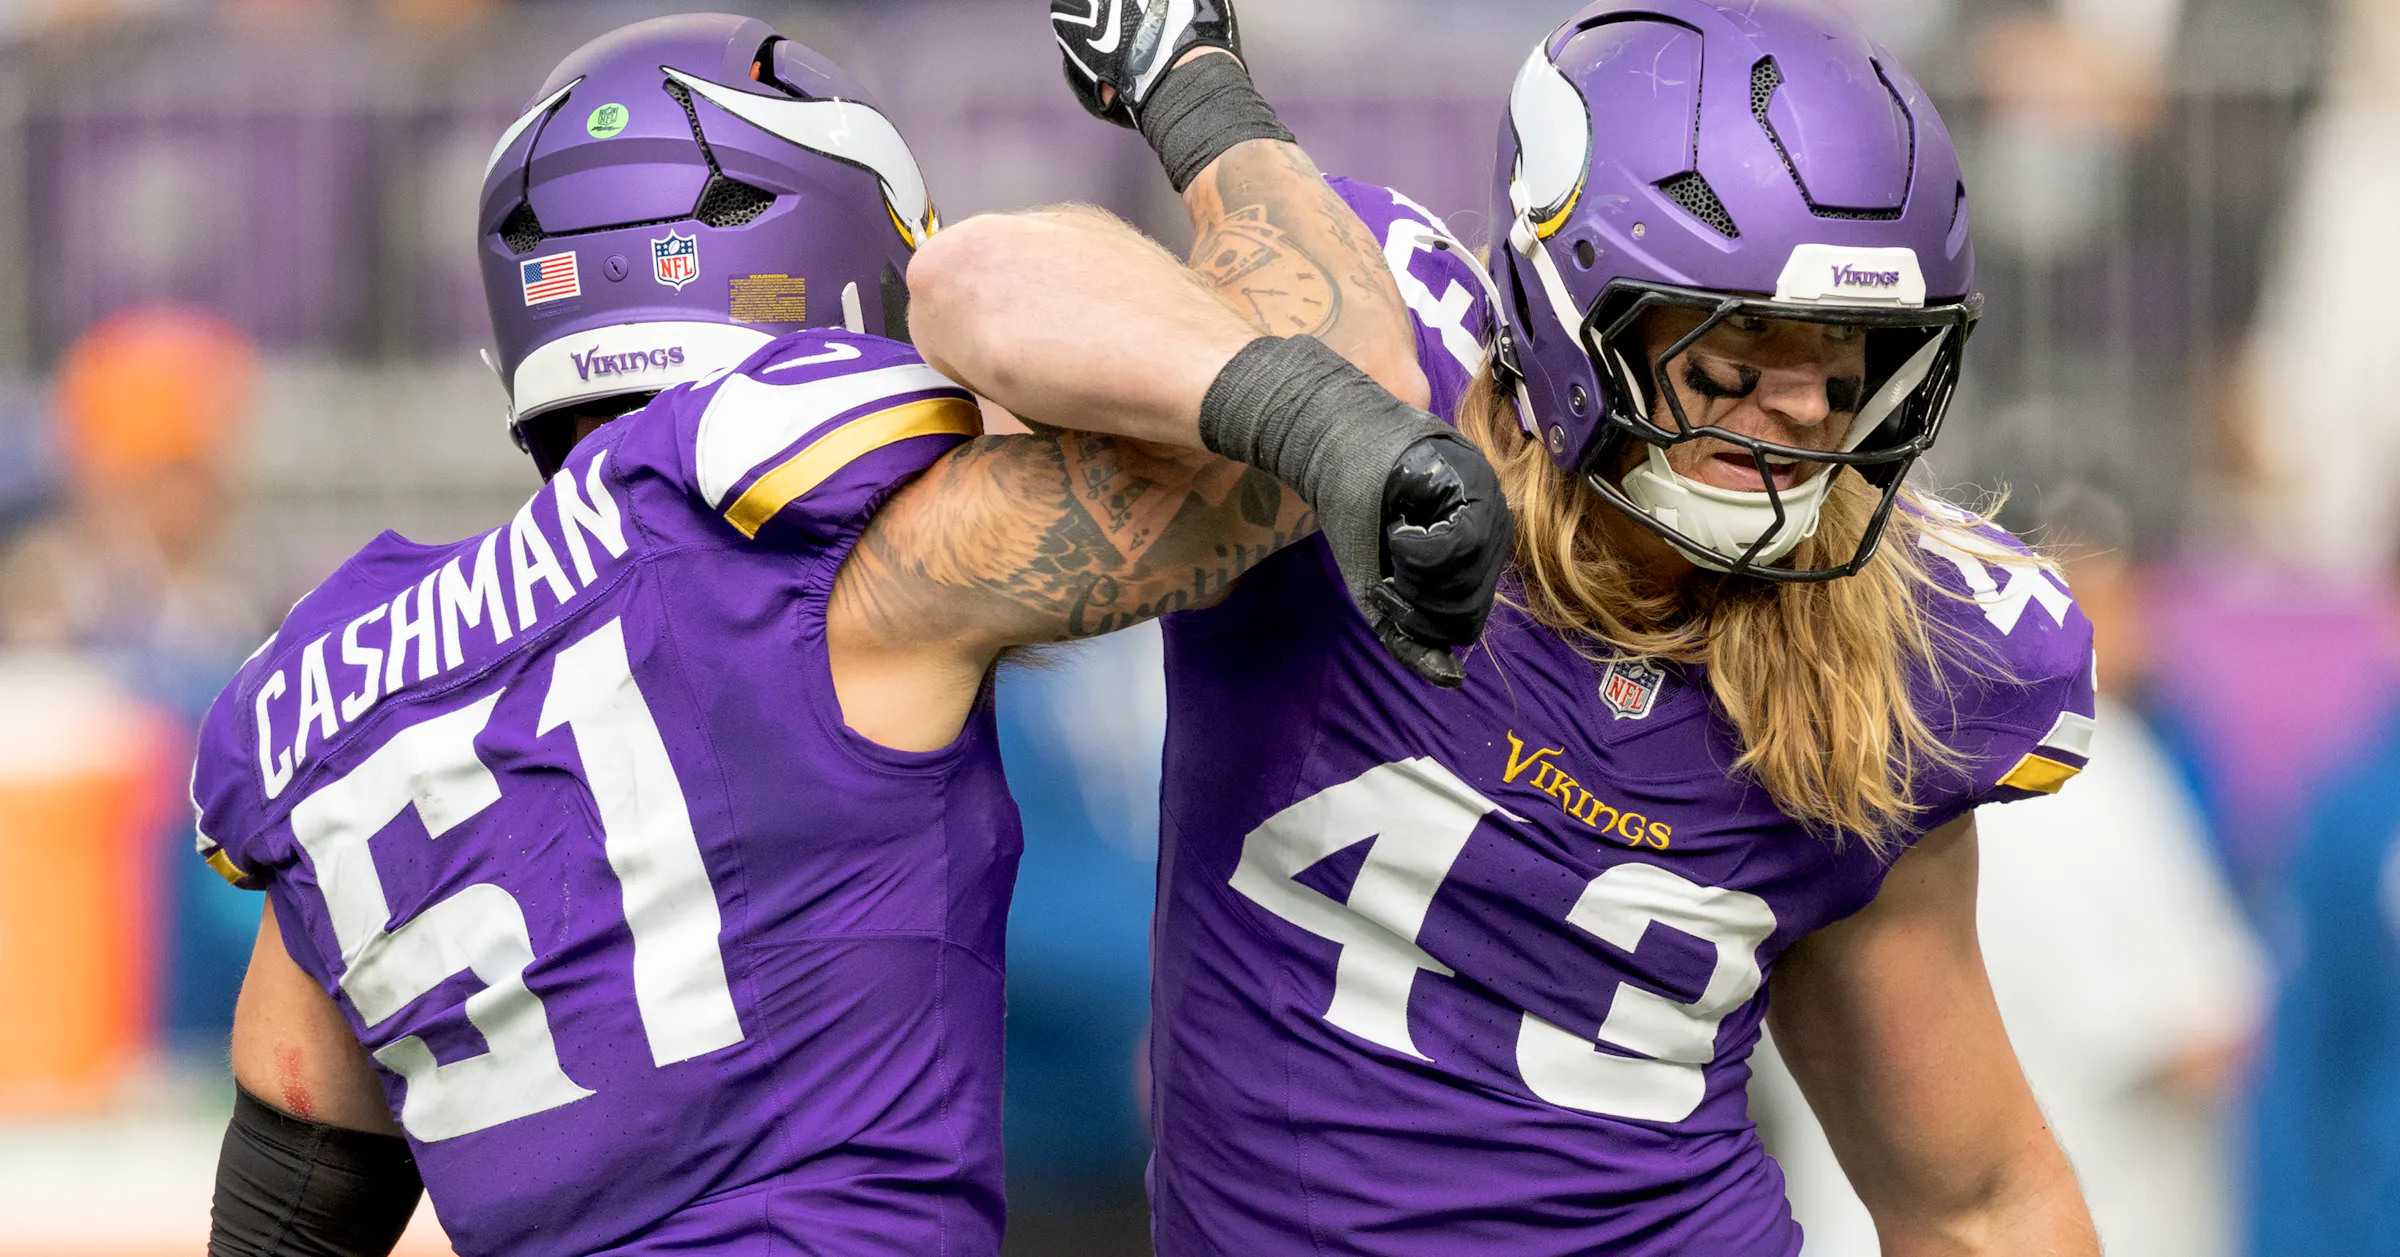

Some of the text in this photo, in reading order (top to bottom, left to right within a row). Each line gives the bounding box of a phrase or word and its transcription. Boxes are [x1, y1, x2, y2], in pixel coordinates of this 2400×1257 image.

[660, 256, 693, 279] NFL
[1831, 263, 1899, 288] VIKINGS
[570, 345, 685, 381] VIKINGS
[255, 449, 629, 800] CASHMAN
[1608, 675, 1644, 711] NFL
[1503, 729, 1672, 850] VIKINGS
[291, 616, 745, 1142] 51
[1228, 756, 1777, 1123] 43
